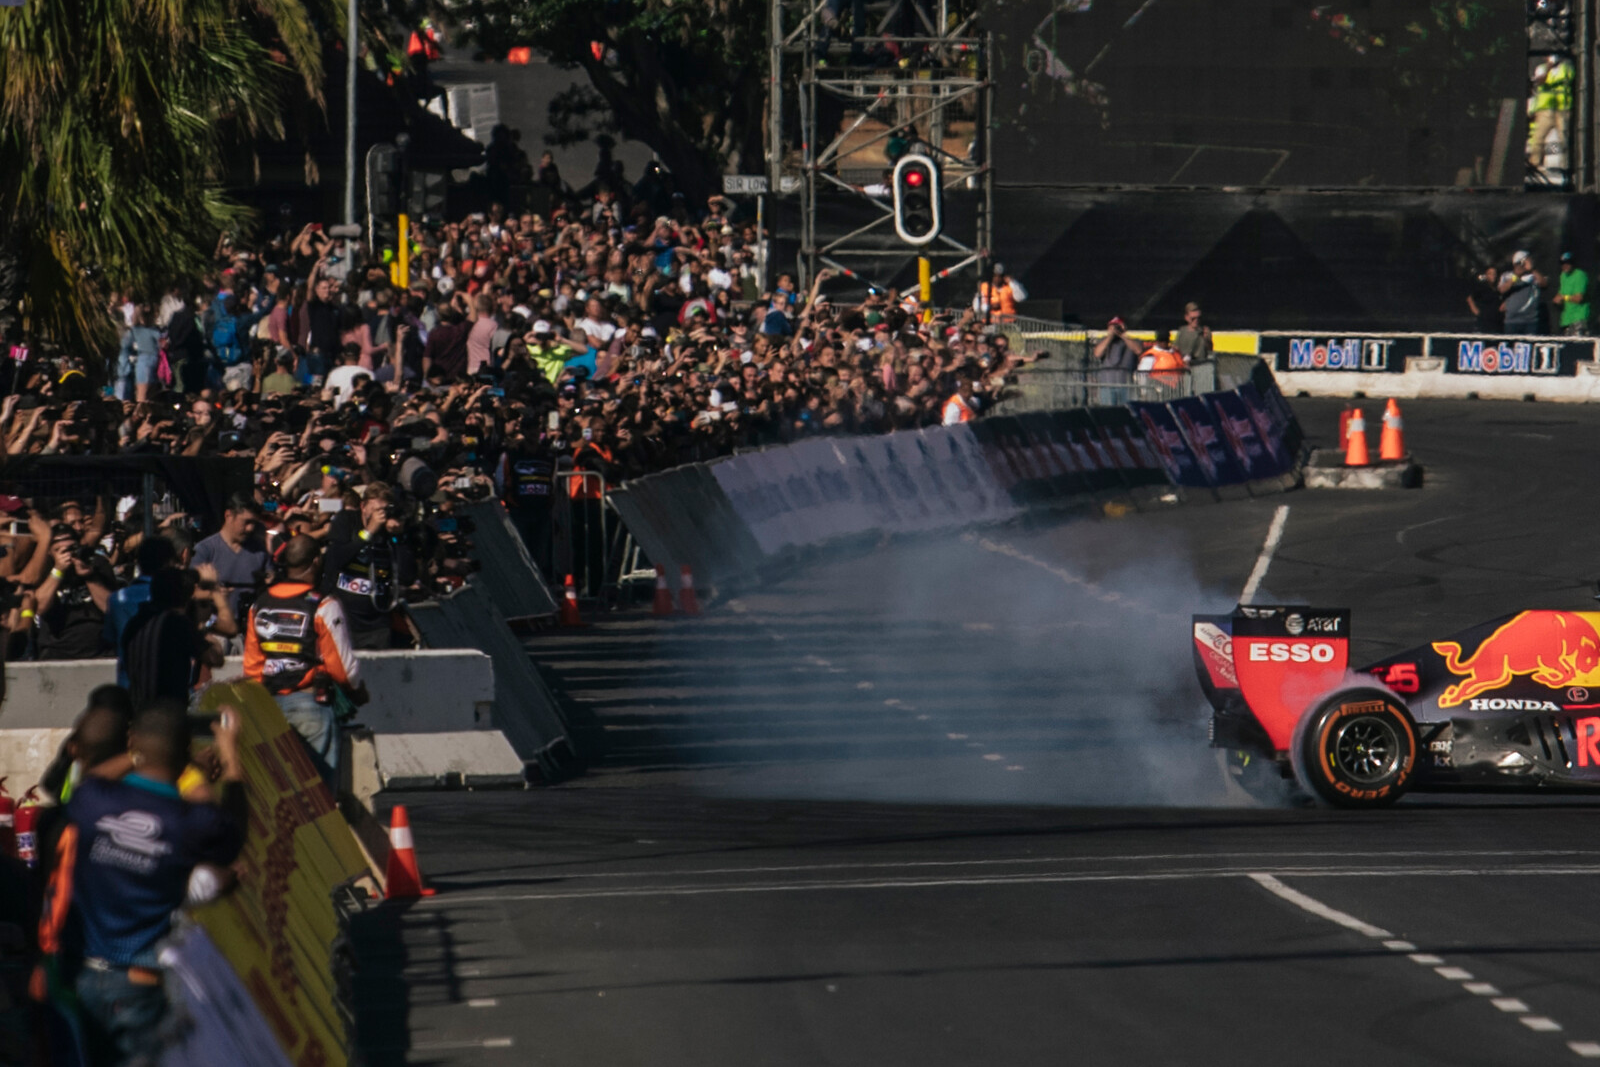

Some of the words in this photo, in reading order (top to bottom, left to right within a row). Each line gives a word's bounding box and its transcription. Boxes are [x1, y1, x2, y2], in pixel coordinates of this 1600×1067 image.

[1289, 339, 1360, 370] Mobil
[1459, 341, 1531, 374] Mobil
[1250, 643, 1334, 663] ESSO
[1470, 699, 1561, 711] HONDA
